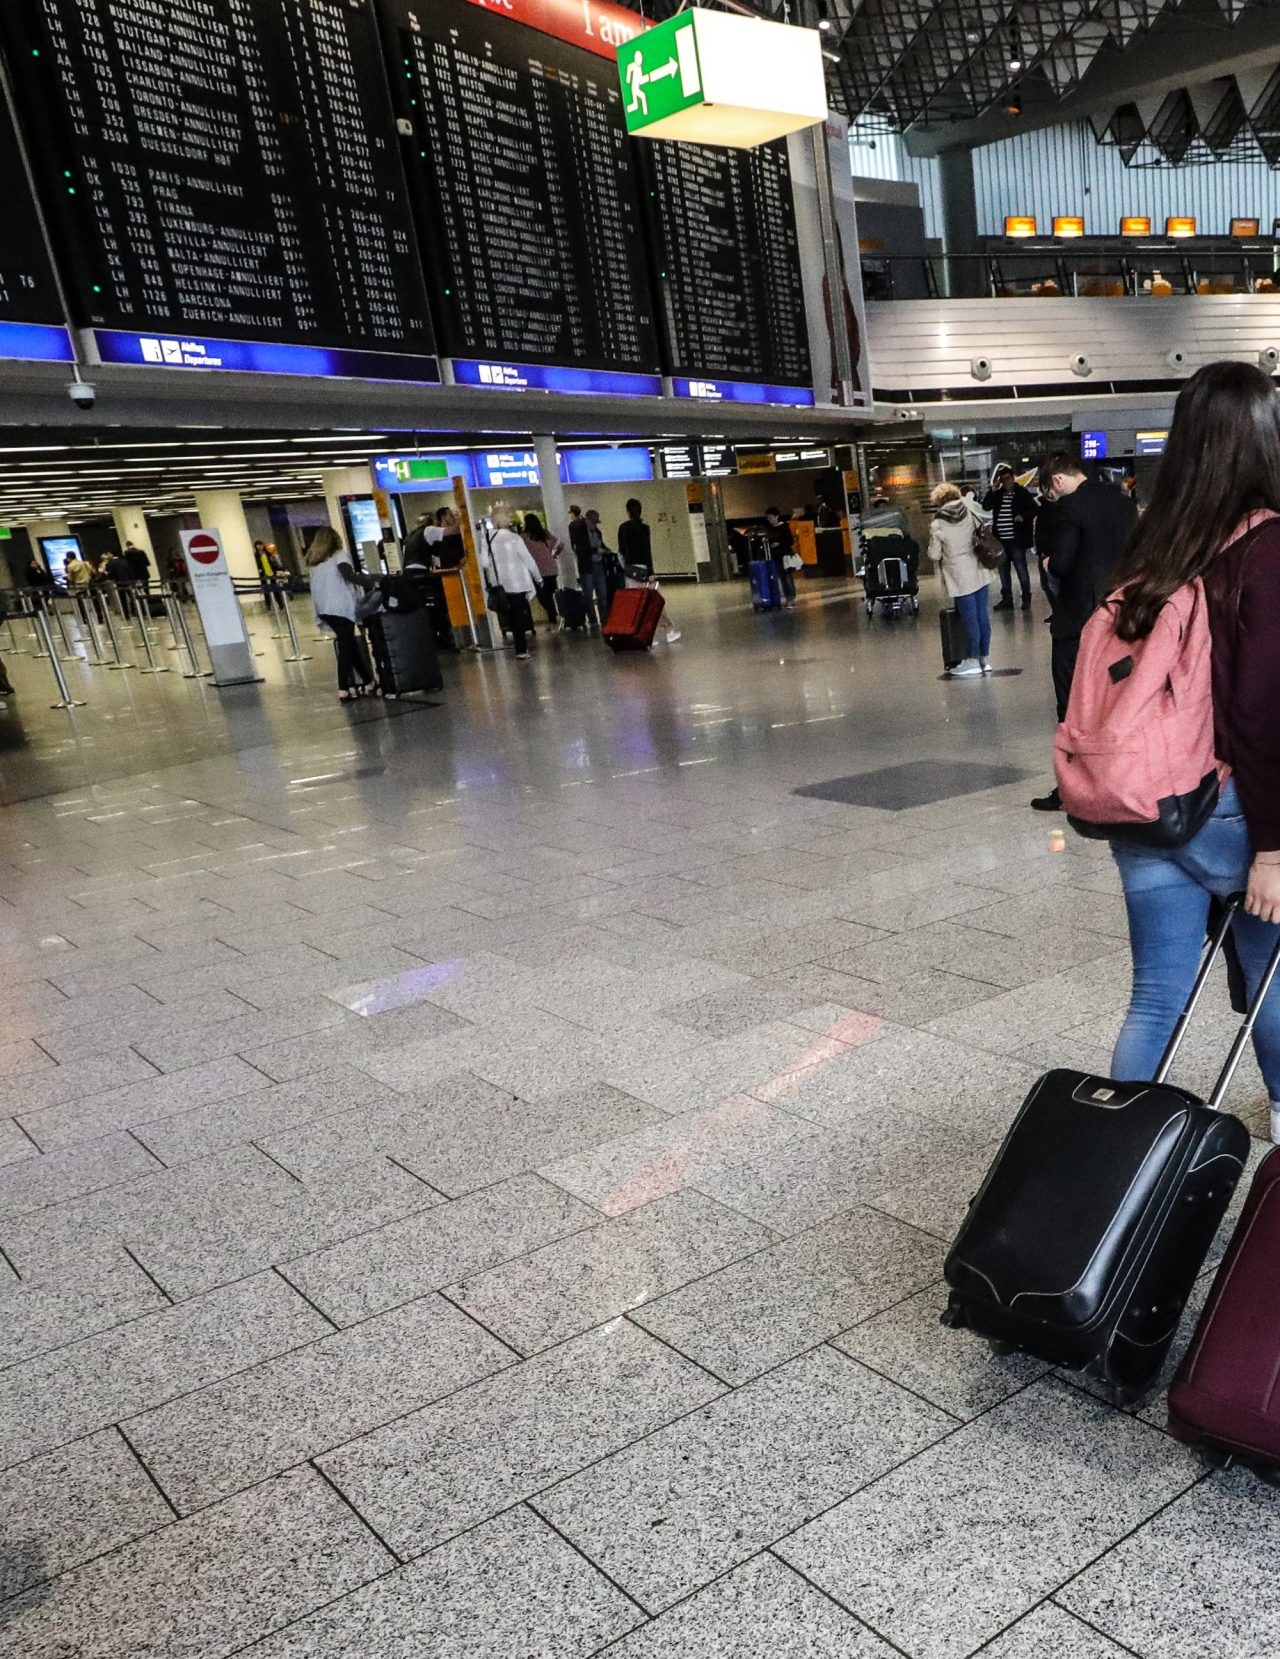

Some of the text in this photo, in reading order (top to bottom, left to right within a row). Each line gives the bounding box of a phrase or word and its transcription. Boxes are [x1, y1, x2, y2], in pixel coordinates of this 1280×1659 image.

[41, 0, 59, 16] LH
[112, 20, 237, 68] STUTTGART-ANNULLIERT
[108, 3, 228, 50] MUENCHEN-ANNULLIERT
[46, 17, 63, 34] LH
[116, 37, 229, 80] MAILAND-ANNULLIERT
[50, 34, 68, 51] LH
[120, 54, 238, 97] LISSABON-ANNULLIERT
[55, 52, 72, 68] AA
[91, 62, 113, 79] 705
[124, 70, 183, 97] CHARLOTTE
[59, 70, 77, 86] AC
[128, 87, 239, 126] TORONTO-ANNULLIERT
[64, 87, 81, 103] LH
[132, 103, 242, 141] DRESDEN-ANNULLIERT
[68, 104, 85, 120] LH
[103, 112, 125, 129] 352
[136, 120, 240, 154] BREMEN-ANNULLIERT
[72, 121, 89, 137] LH
[101, 128, 129, 145] 3504
[140, 136, 209, 162] DUESSELDORF
[81, 155, 98, 170] LH
[147, 168, 244, 198] PARIS-ANNULLIERT
[151, 184, 178, 200] PRAG
[94, 205, 110, 219] LH
[159, 216, 275, 245] LUXEMBURG-ANNULLIERT
[155, 200, 194, 218] TIRANA
[98, 221, 114, 235] LH
[163, 231, 268, 258] SEVILLA-ANNULLIERT
[102, 237, 118, 251] LH
[166, 247, 260, 270] MALTA-ANNULLIERT
[106, 253, 122, 267] SK
[170, 262, 284, 287] KOPENHAGE-ANNULLIERT
[110, 269, 126, 283] LH
[174, 277, 282, 301] HELSINKI-ANNULLIERT
[114, 285, 130, 298] LH
[177, 292, 231, 309] BARCELONA
[118, 301, 134, 314] LH
[181, 307, 283, 328] ZUERICH-ANNULLIERT
